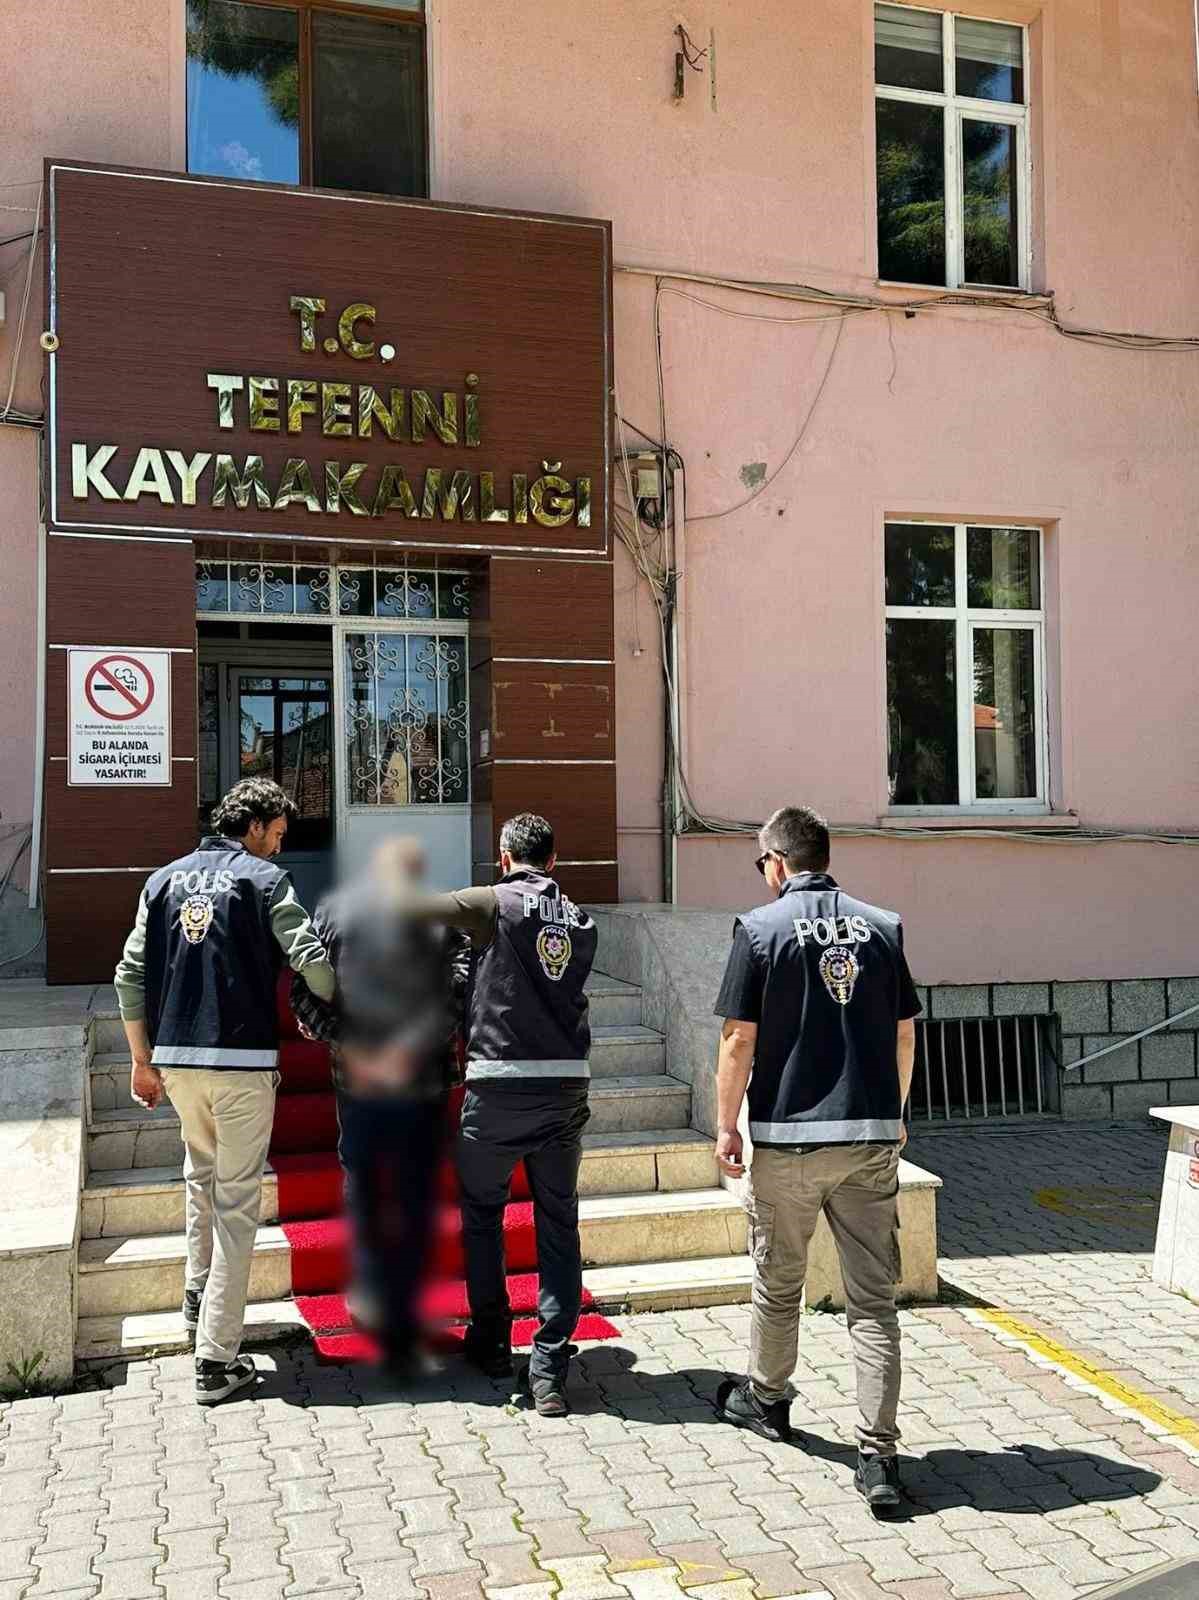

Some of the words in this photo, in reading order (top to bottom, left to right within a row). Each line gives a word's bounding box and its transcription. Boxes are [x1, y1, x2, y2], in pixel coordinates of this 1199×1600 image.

[289, 295, 396, 361] T.C.
[207, 372, 481, 448] TEFENNİ
[71, 442, 591, 528] KAYMAKAMLIĞI
[79, 753, 116, 764] SİGARA
[118, 752, 161, 767] İÇİLMESİ
[92, 741, 106, 750] BU
[108, 741, 149, 751] ALANDA
[94, 769, 147, 779] YASAKTIR!
